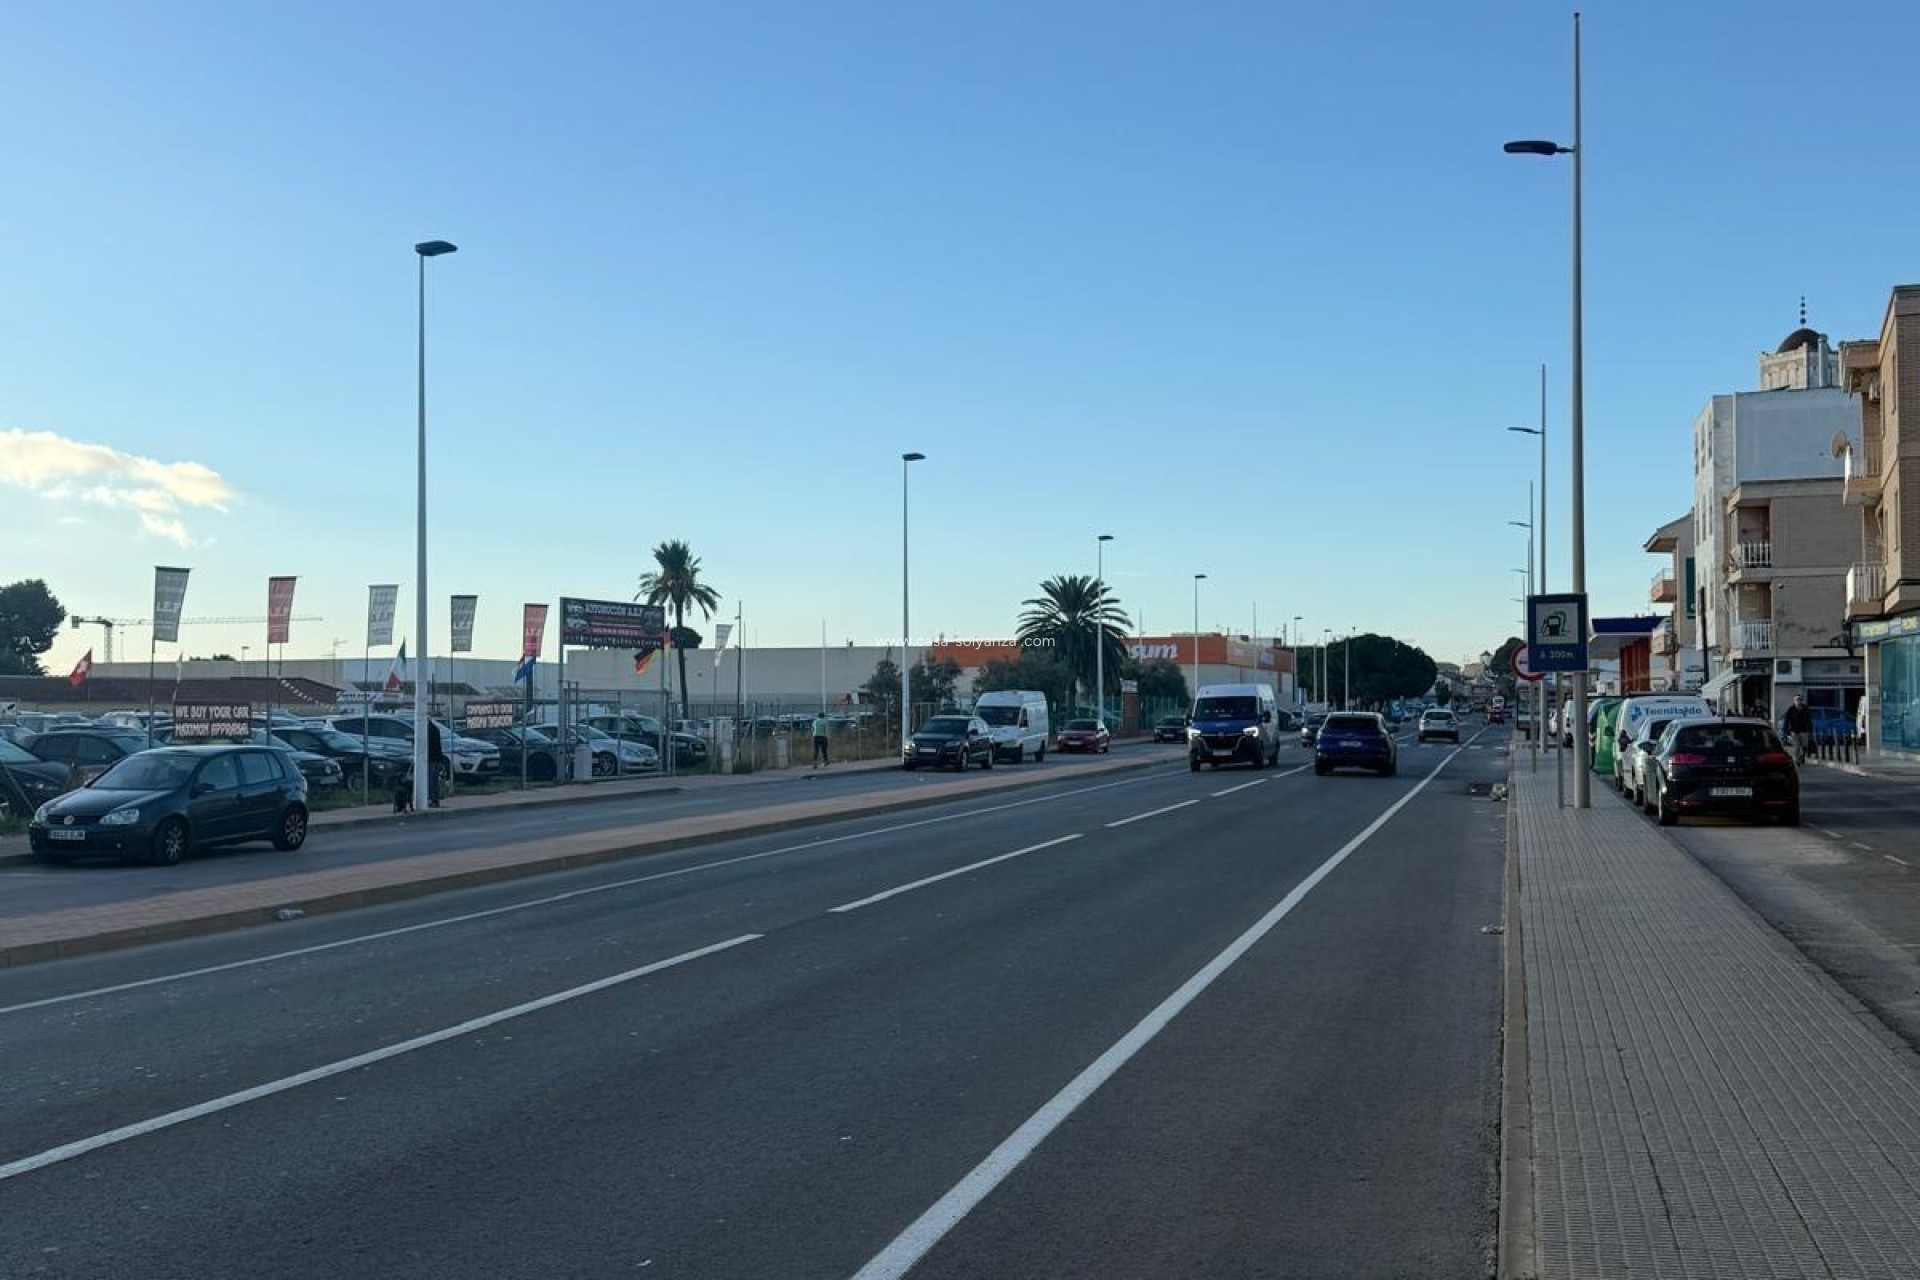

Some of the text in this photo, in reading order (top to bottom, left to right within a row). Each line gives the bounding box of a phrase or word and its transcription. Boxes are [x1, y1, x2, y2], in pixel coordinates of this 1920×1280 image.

[176, 705, 249, 719] WE BUY YOUR CAR
